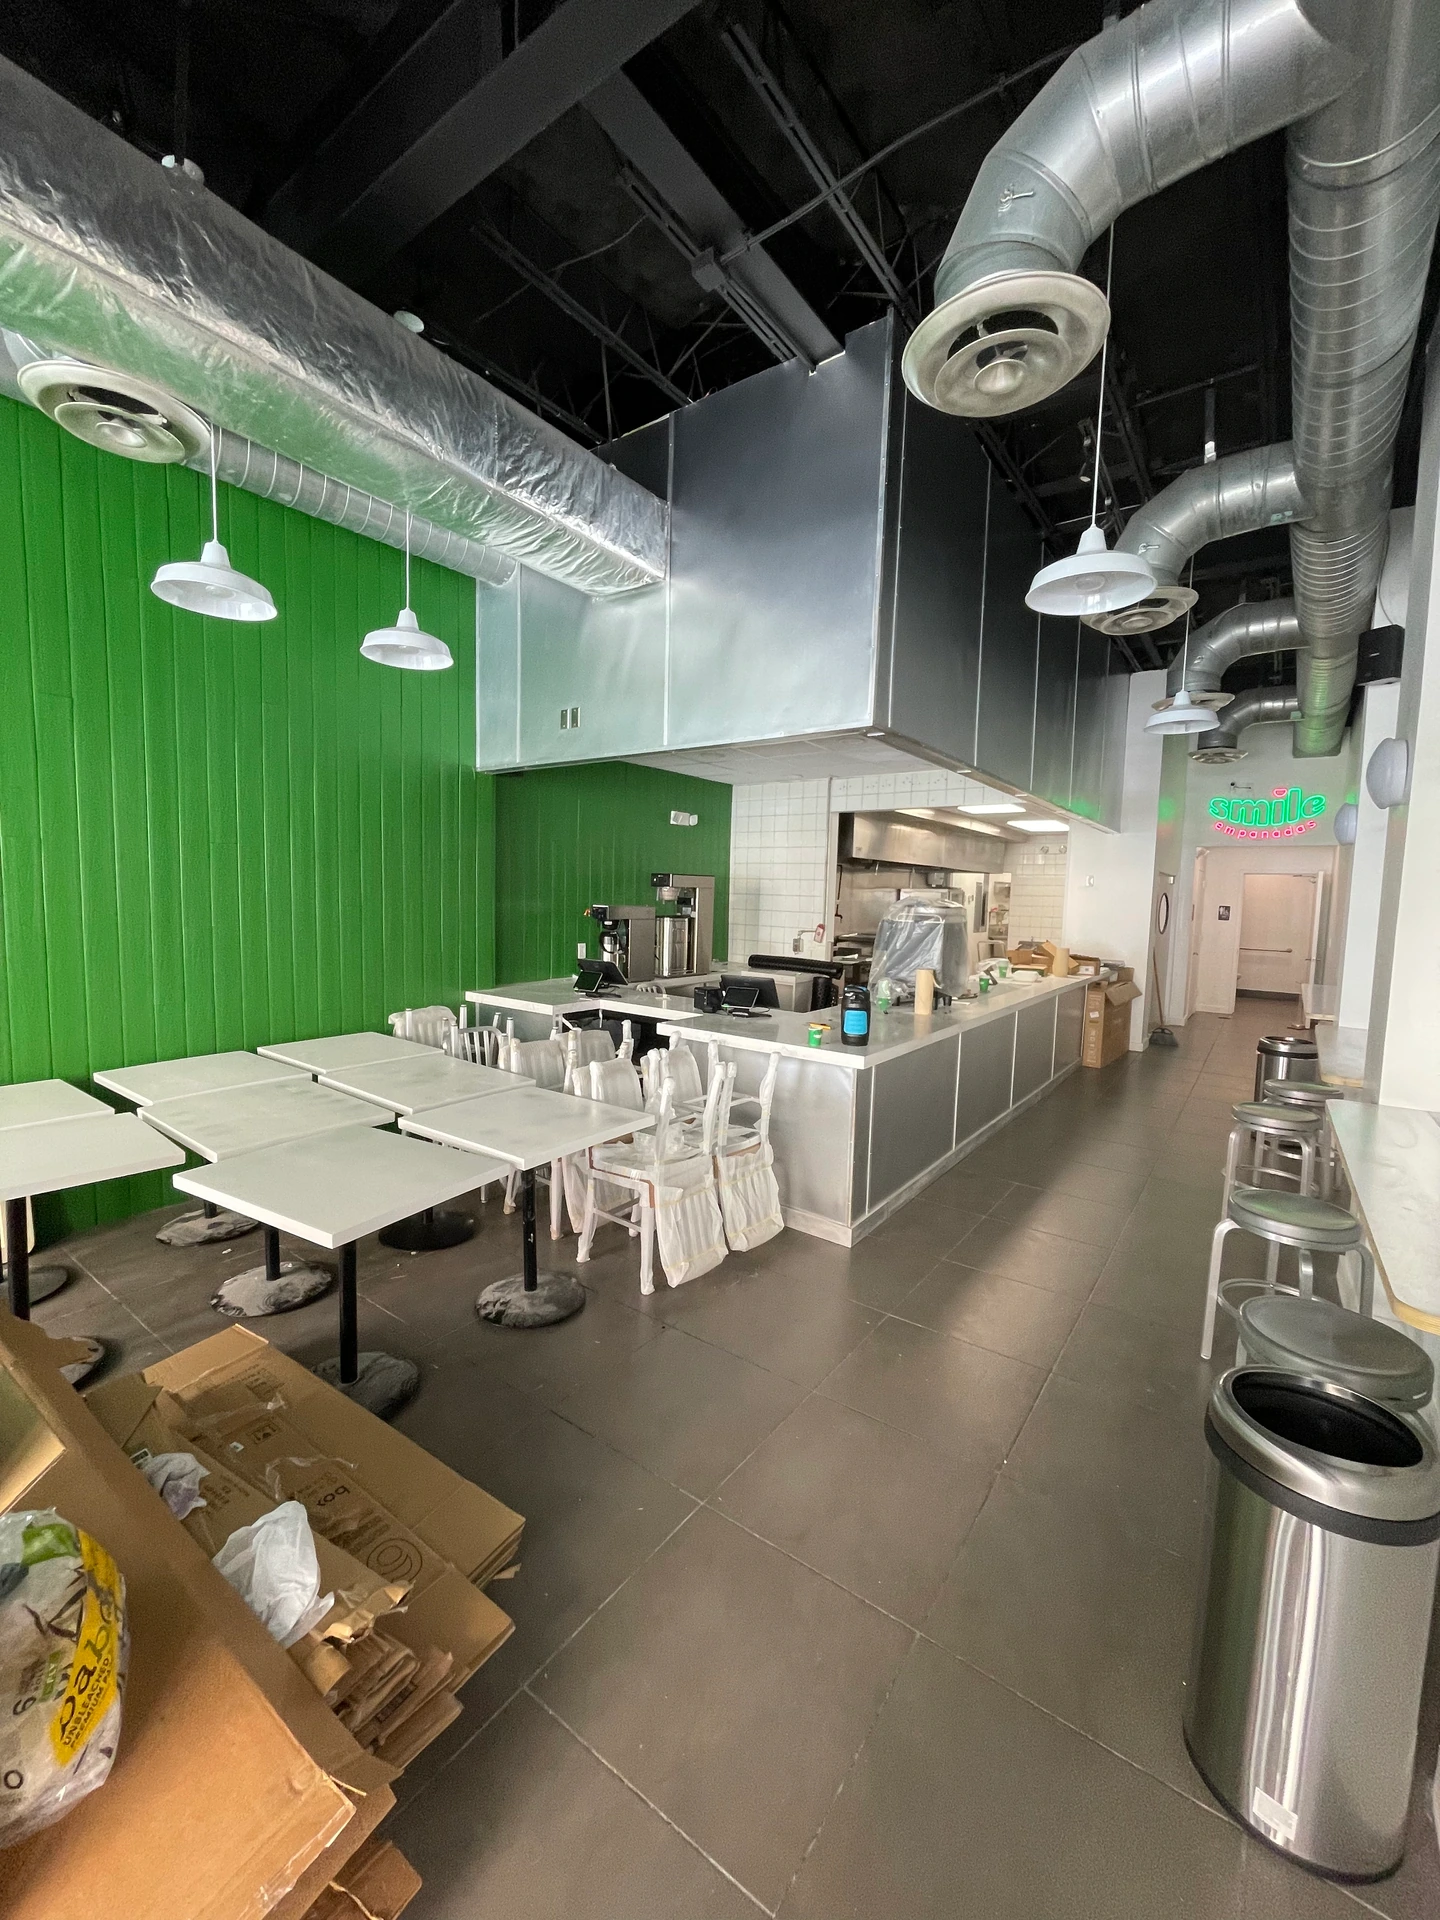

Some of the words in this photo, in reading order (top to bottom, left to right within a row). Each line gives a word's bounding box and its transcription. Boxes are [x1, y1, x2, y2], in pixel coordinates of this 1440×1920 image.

[1209, 786, 1326, 826] smile
[1214, 820, 1317, 839] empanadas
[63, 1656, 110, 1746] UNBLEACHED
